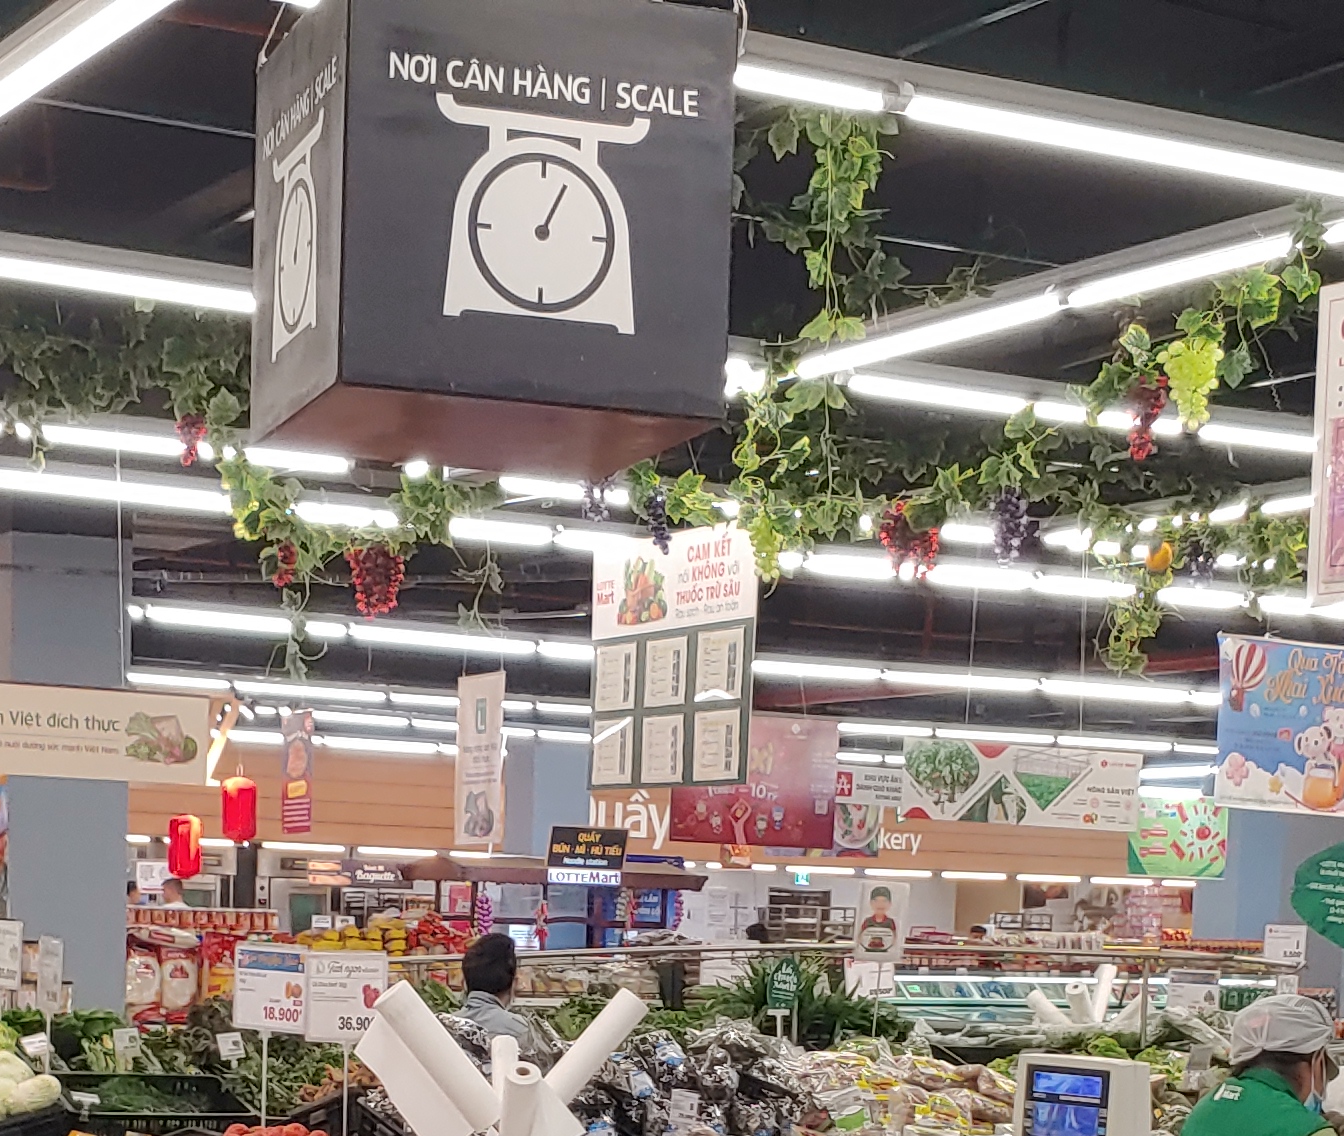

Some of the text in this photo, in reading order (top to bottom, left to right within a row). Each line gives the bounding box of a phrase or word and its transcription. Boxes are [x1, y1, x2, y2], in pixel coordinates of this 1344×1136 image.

[315, 55, 337, 105] SCALE
[388, 51, 699, 117] NƠI CÂN HÀNG SCALE
[687, 532, 732, 563] CAM KẾT
[691, 560, 725, 581] KHÔNG
[596, 589, 615, 606] Mart
[675, 578, 741, 605] THUỐC TRỪ SÂU
[9, 710, 42, 729] Việt
[47, 712, 80, 730] đích
[85, 716, 121, 735] thực
[878, 827, 923, 855] kery
